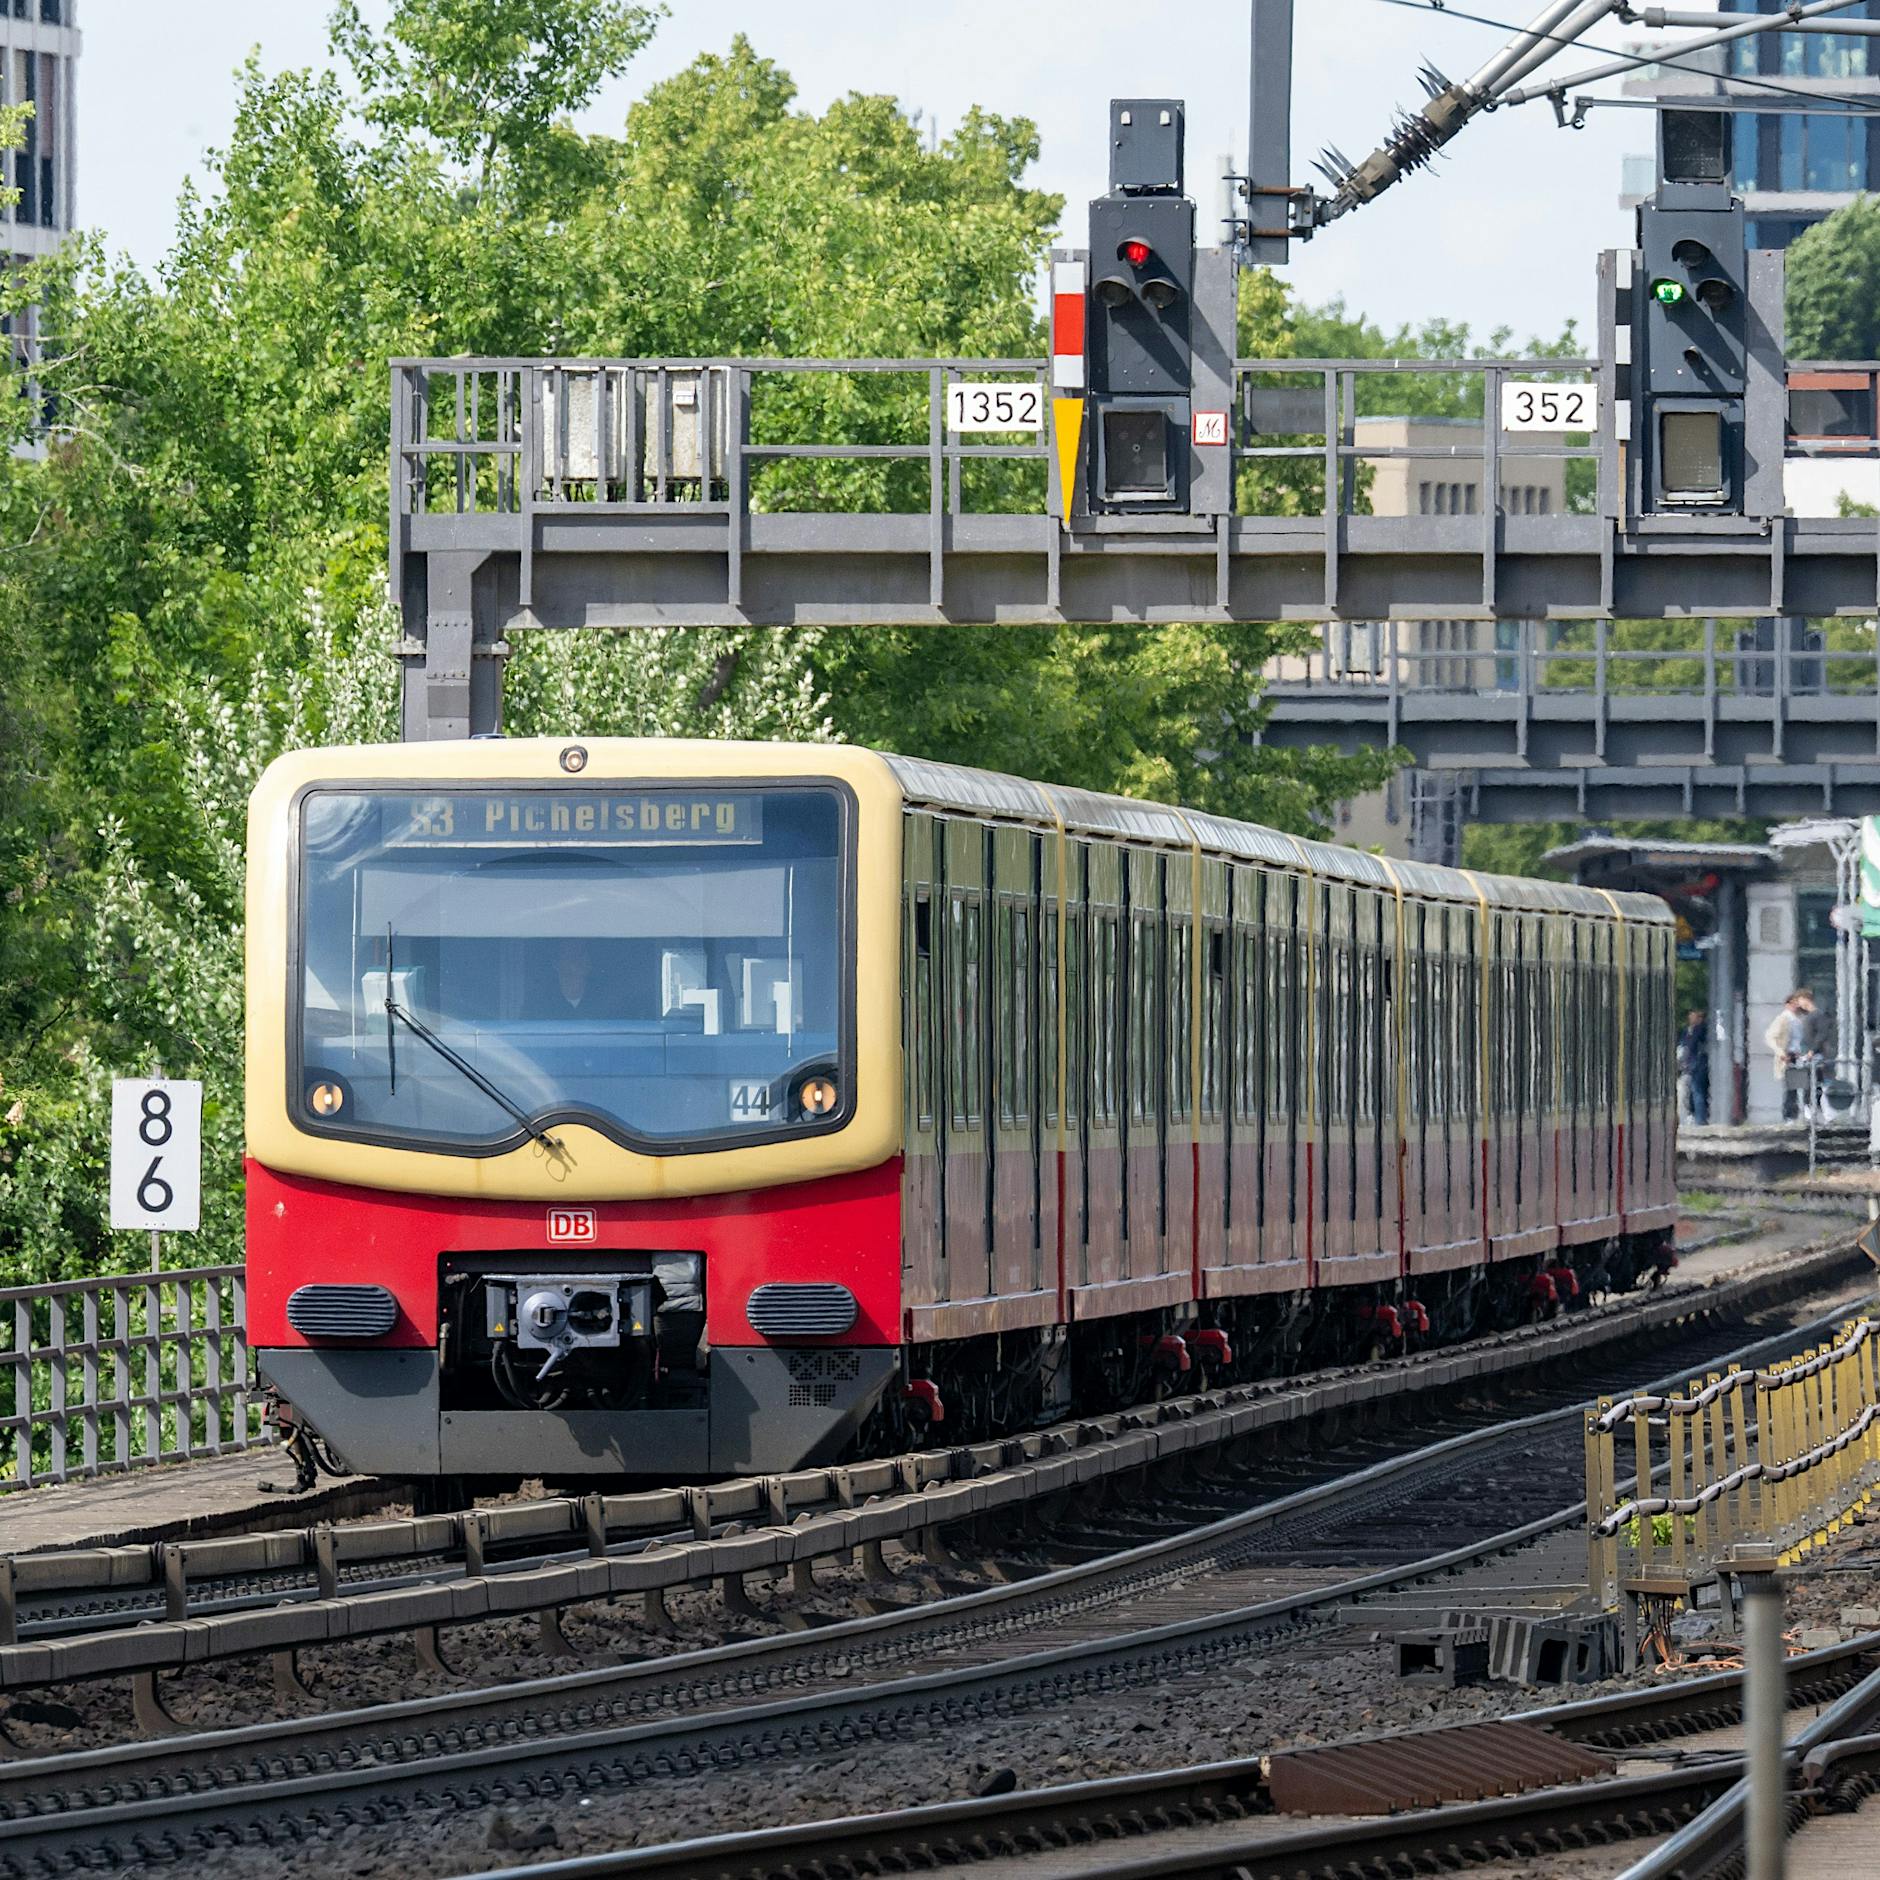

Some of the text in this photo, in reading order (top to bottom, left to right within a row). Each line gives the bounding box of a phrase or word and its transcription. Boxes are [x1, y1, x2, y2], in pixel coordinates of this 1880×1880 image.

[955, 391, 1037, 423] 1352
[1516, 391, 1583, 423] 352
[486, 800, 735, 834] Pichelsberg
[732, 1086, 769, 1115] 44
[139, 1089, 172, 1146] 8
[137, 1156, 173, 1212] 6
[555, 1214, 590, 1236] DB
